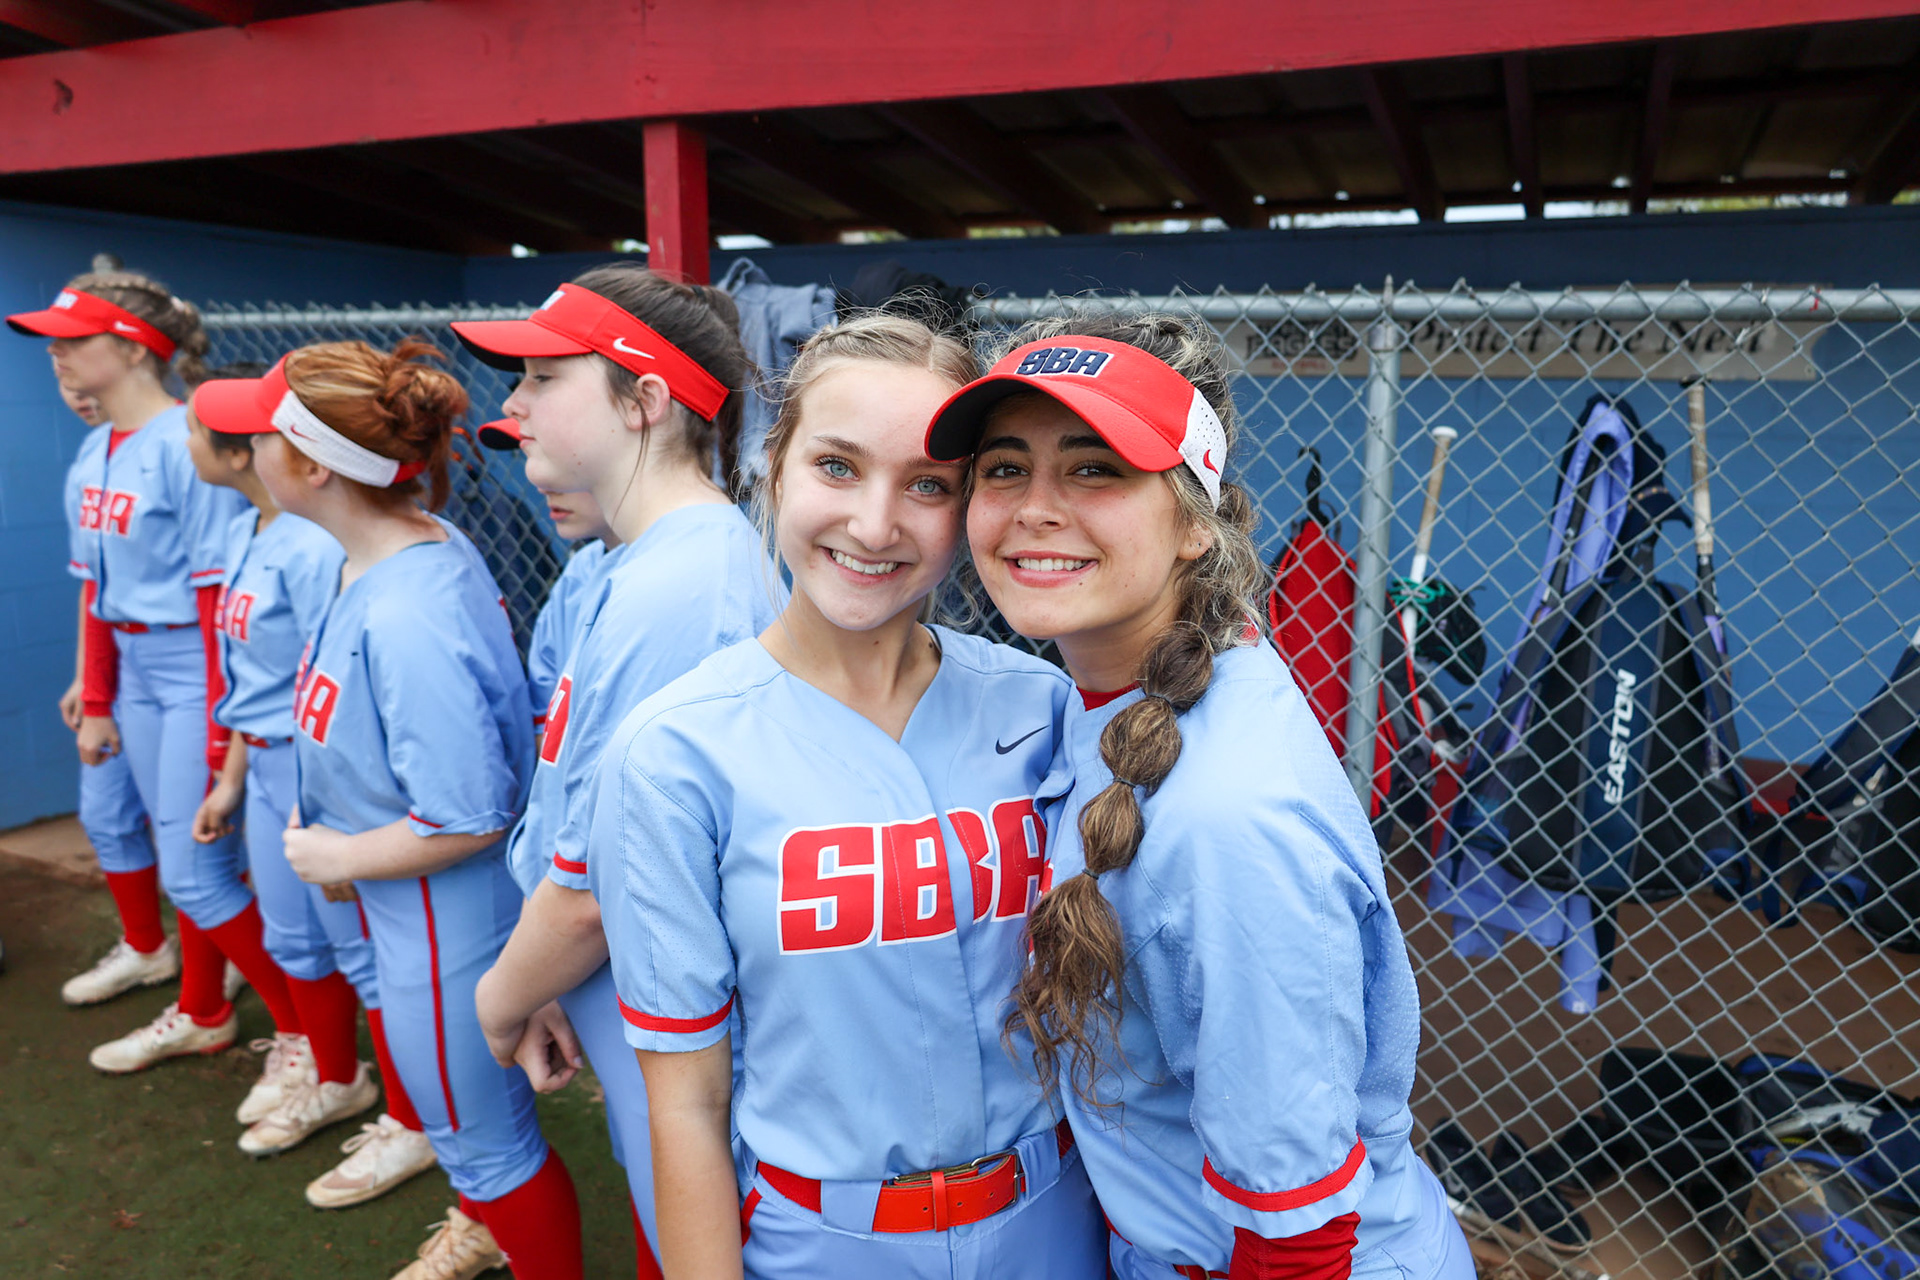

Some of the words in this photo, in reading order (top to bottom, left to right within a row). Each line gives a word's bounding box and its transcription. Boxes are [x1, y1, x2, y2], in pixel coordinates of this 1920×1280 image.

[1014, 347, 1114, 378] SBA
[1560, 319, 1646, 353] The
[1604, 669, 1636, 805] EASTON
[777, 795, 1048, 955] SBA
